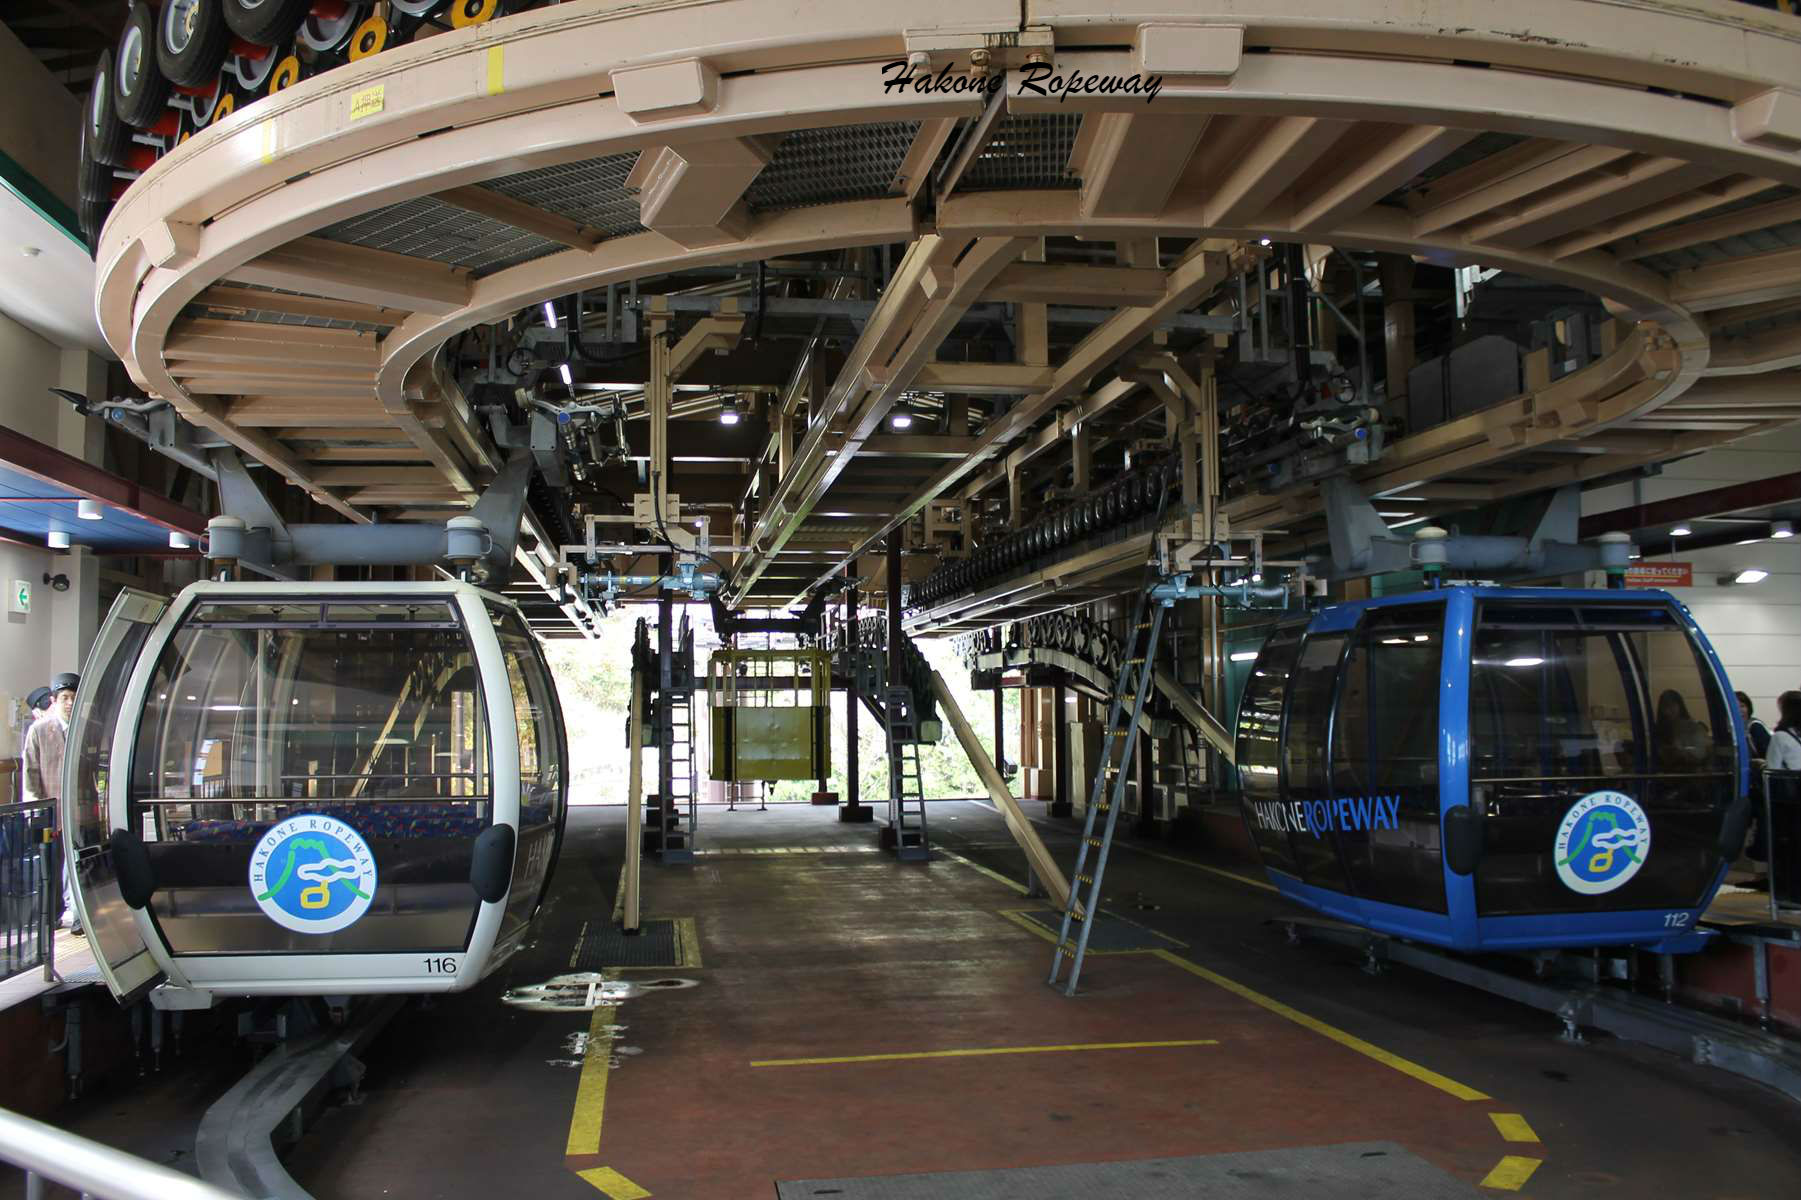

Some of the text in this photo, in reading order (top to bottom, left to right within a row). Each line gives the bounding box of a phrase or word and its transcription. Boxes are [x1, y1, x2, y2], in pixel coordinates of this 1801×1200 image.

[253, 819, 373, 882] HAKONE ROPEWAY
[1664, 911, 1689, 928] 112
[423, 957, 457, 974] 116
